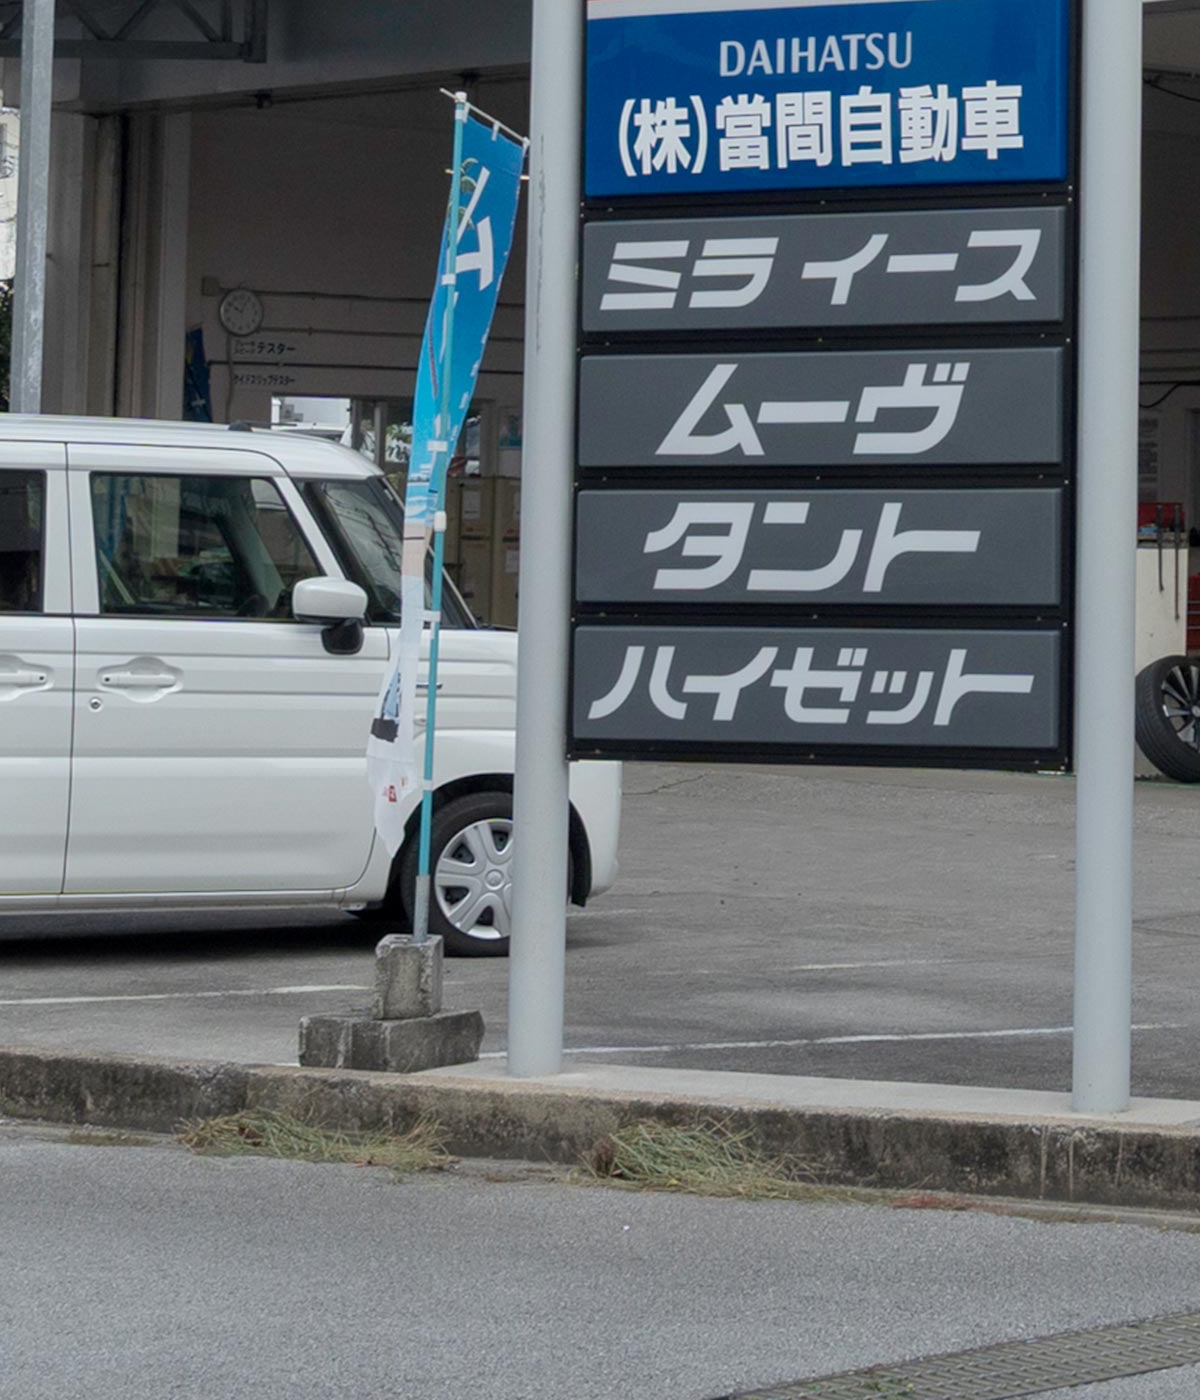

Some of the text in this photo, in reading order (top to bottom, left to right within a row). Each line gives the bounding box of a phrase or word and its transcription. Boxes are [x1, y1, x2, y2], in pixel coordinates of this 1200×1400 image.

[718, 31, 913, 77] DAIHATSU
[618, 80, 1024, 177] (株)當間自動車
[600, 228, 1042, 310] ミラ イース
[655, 362, 970, 456] ムーヴ
[643, 502, 981, 593] タント
[587, 646, 1034, 726] ハイゼット
